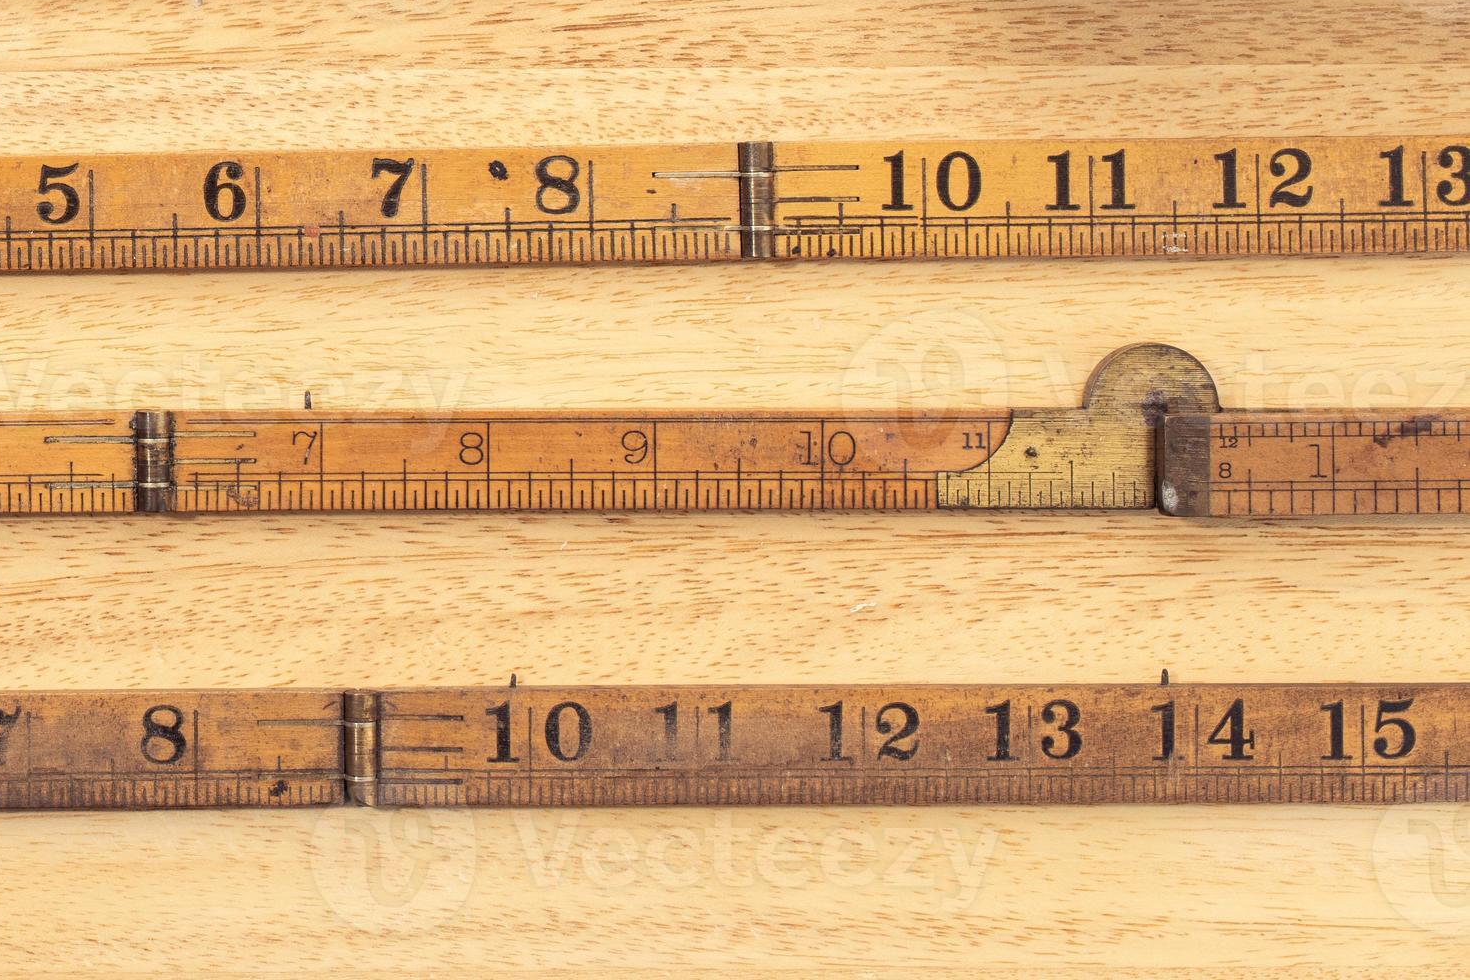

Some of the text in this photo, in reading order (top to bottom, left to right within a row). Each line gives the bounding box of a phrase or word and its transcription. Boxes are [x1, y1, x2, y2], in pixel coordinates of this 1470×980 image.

[36, 163, 80, 224] 5
[203, 161, 247, 222] 6
[371, 158, 415, 218] 7
[535, 154, 580, 215] 8
[882, 150, 982, 211] 10
[1045, 149, 1136, 210] 11
[1212, 147, 1314, 209] 12
[1378, 145, 1470, 207] 13
[291, 431, 318, 466] 7
[458, 431, 485, 466] 8
[620, 430, 649, 465] 9
[800, 430, 857, 467] 10
[962, 432, 986, 450] 11
[1219, 436, 1238, 449] 12
[1218, 462, 1232, 479] 8
[1309, 443, 1327, 478] 1
[141, 704, 187, 766] 8
[484, 701, 593, 763] 10
[654, 701, 734, 762] 11
[819, 700, 922, 762] 12
[985, 699, 1083, 762] 13
[1150, 698, 1255, 761] 14
[1320, 697, 1417, 761] 15
